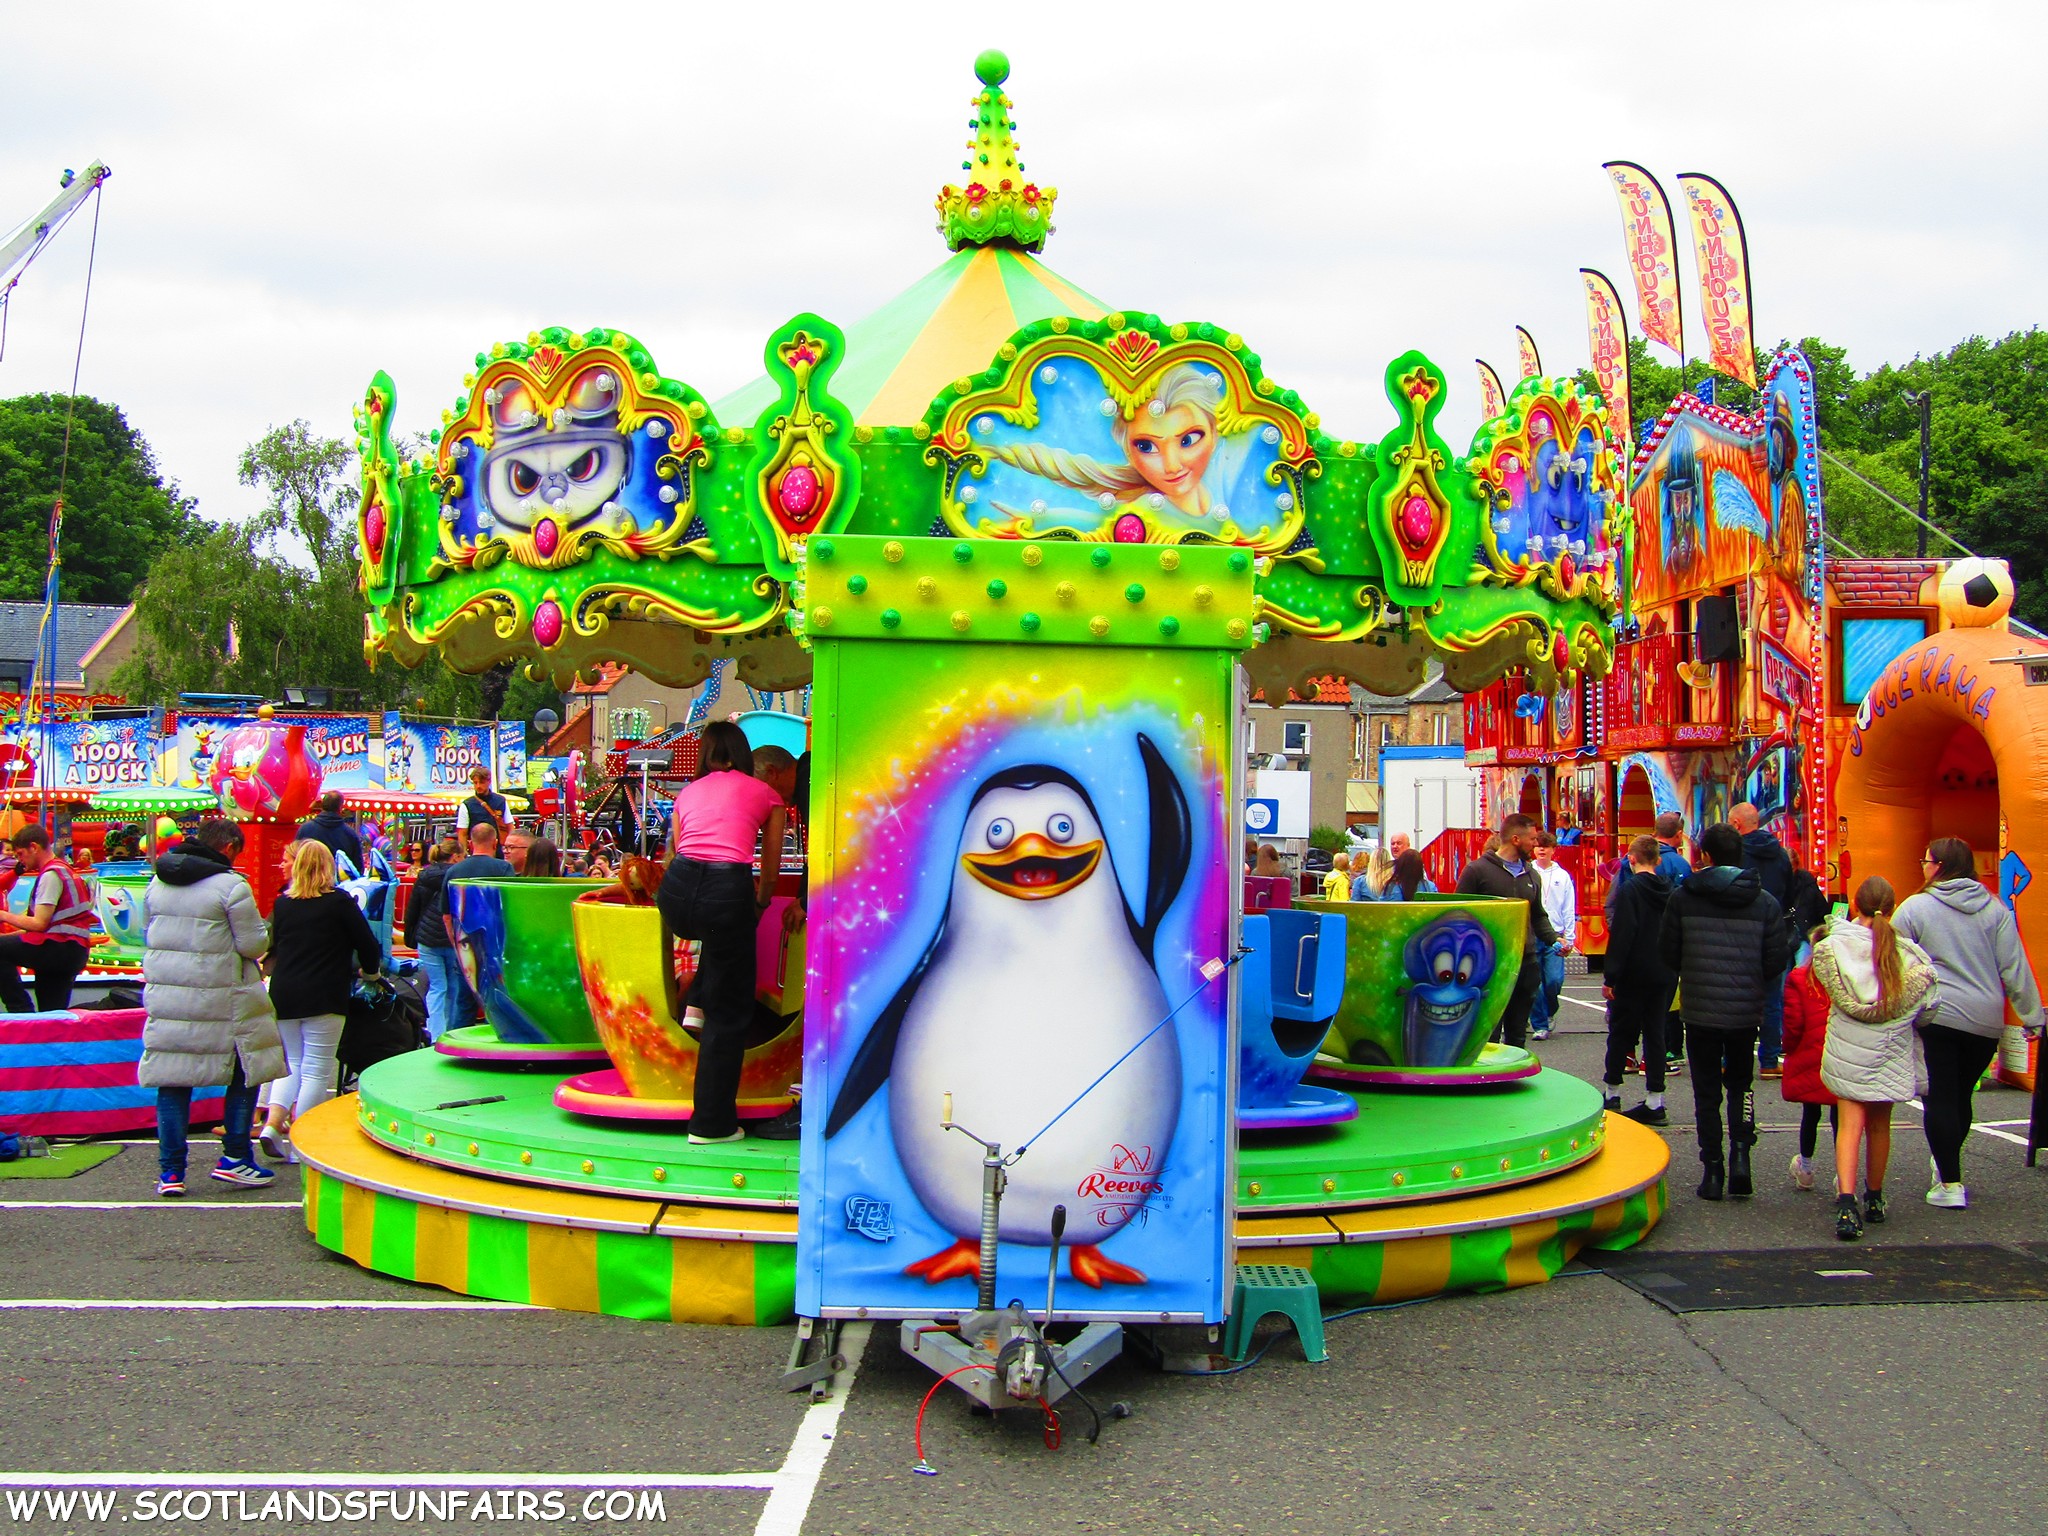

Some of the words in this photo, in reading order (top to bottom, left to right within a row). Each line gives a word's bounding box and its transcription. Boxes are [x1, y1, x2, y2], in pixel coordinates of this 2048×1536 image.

[500, 730, 520, 741] Prize
[1675, 725, 1723, 742] CRAZY
[71, 740, 139, 762] HOOK
[313, 733, 368, 760] DUCK
[434, 746, 482, 766] HOOK
[64, 764, 82, 784] A
[86, 761, 148, 782] DUCK
[321, 757, 363, 782] ytime
[431, 764, 442, 784] A
[177, 821, 199, 829] OOK
[1077, 1172, 1165, 1199] Reeves
[848, 1201, 893, 1229] ECA
